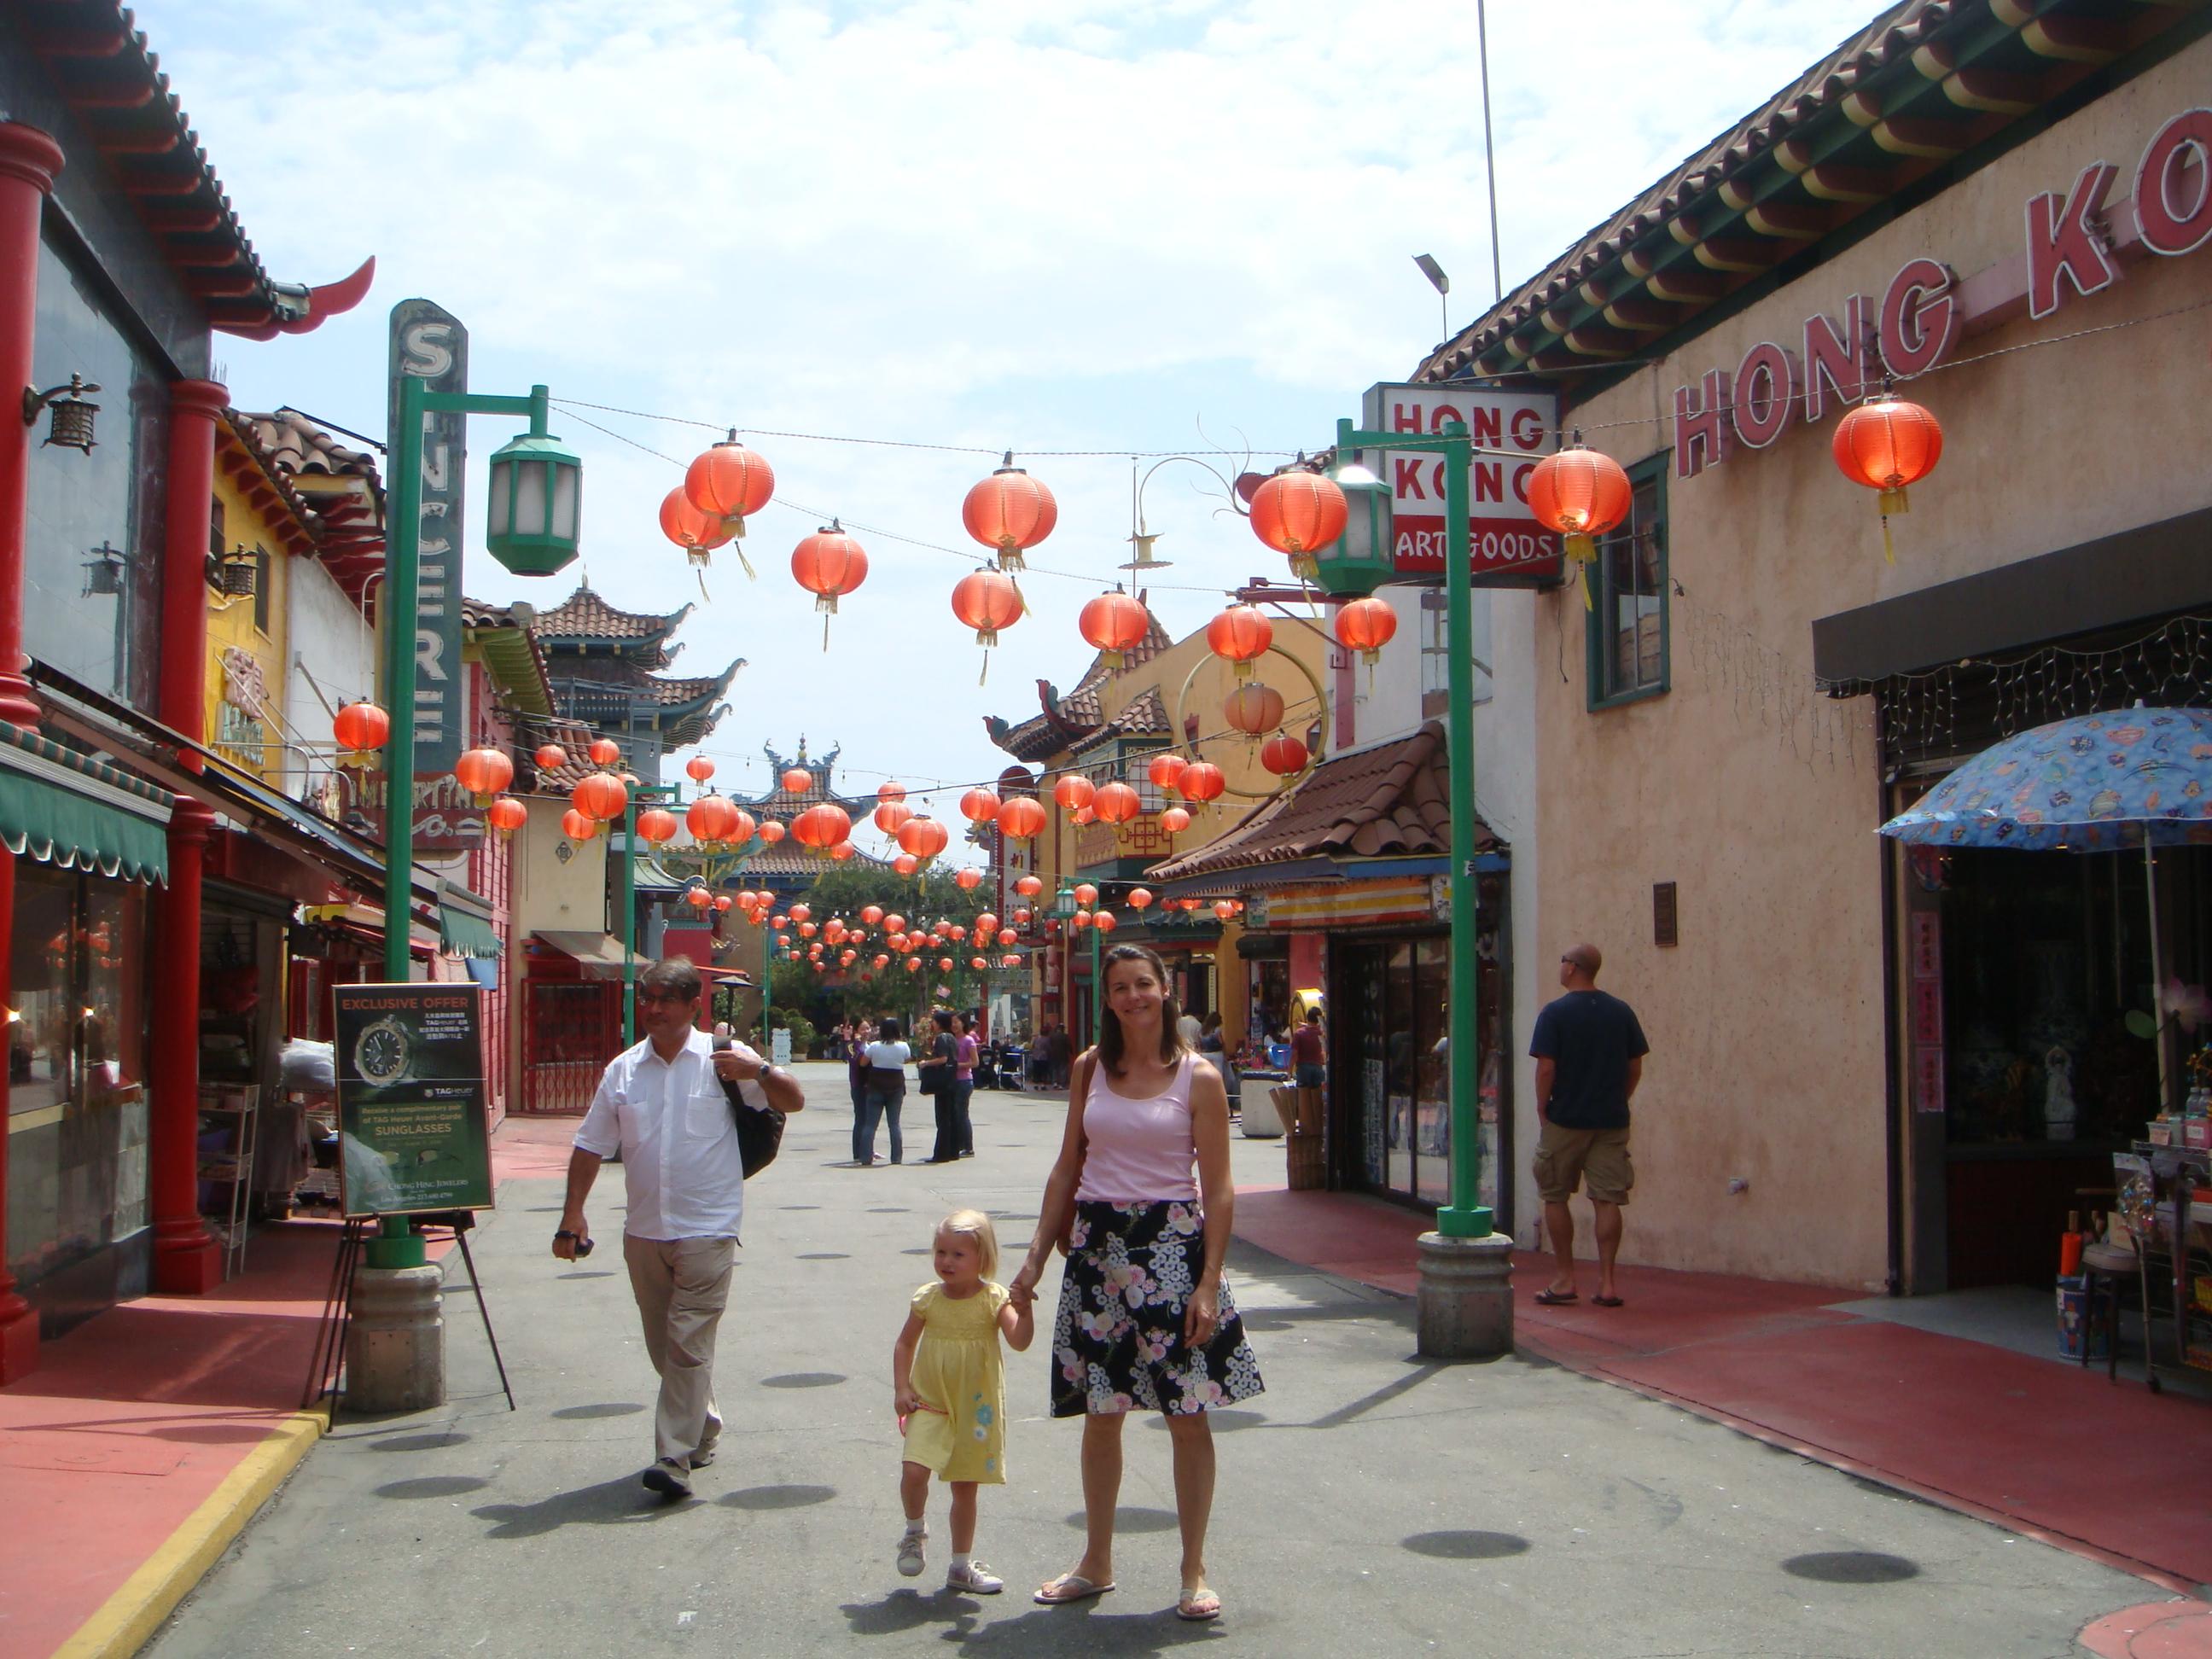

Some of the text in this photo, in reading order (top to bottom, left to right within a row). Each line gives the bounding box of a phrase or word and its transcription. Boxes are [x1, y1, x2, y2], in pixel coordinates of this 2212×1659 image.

[1673, 258, 1956, 480] HONG
[1394, 404, 1544, 450] HONG
[1394, 531, 1553, 560] ART GOODS
[349, 780, 483, 809] IMRTIN
[342, 997, 469, 1010] EXCLUSIVE OFFER
[375, 1123, 451, 1136] SUNGLASSES
